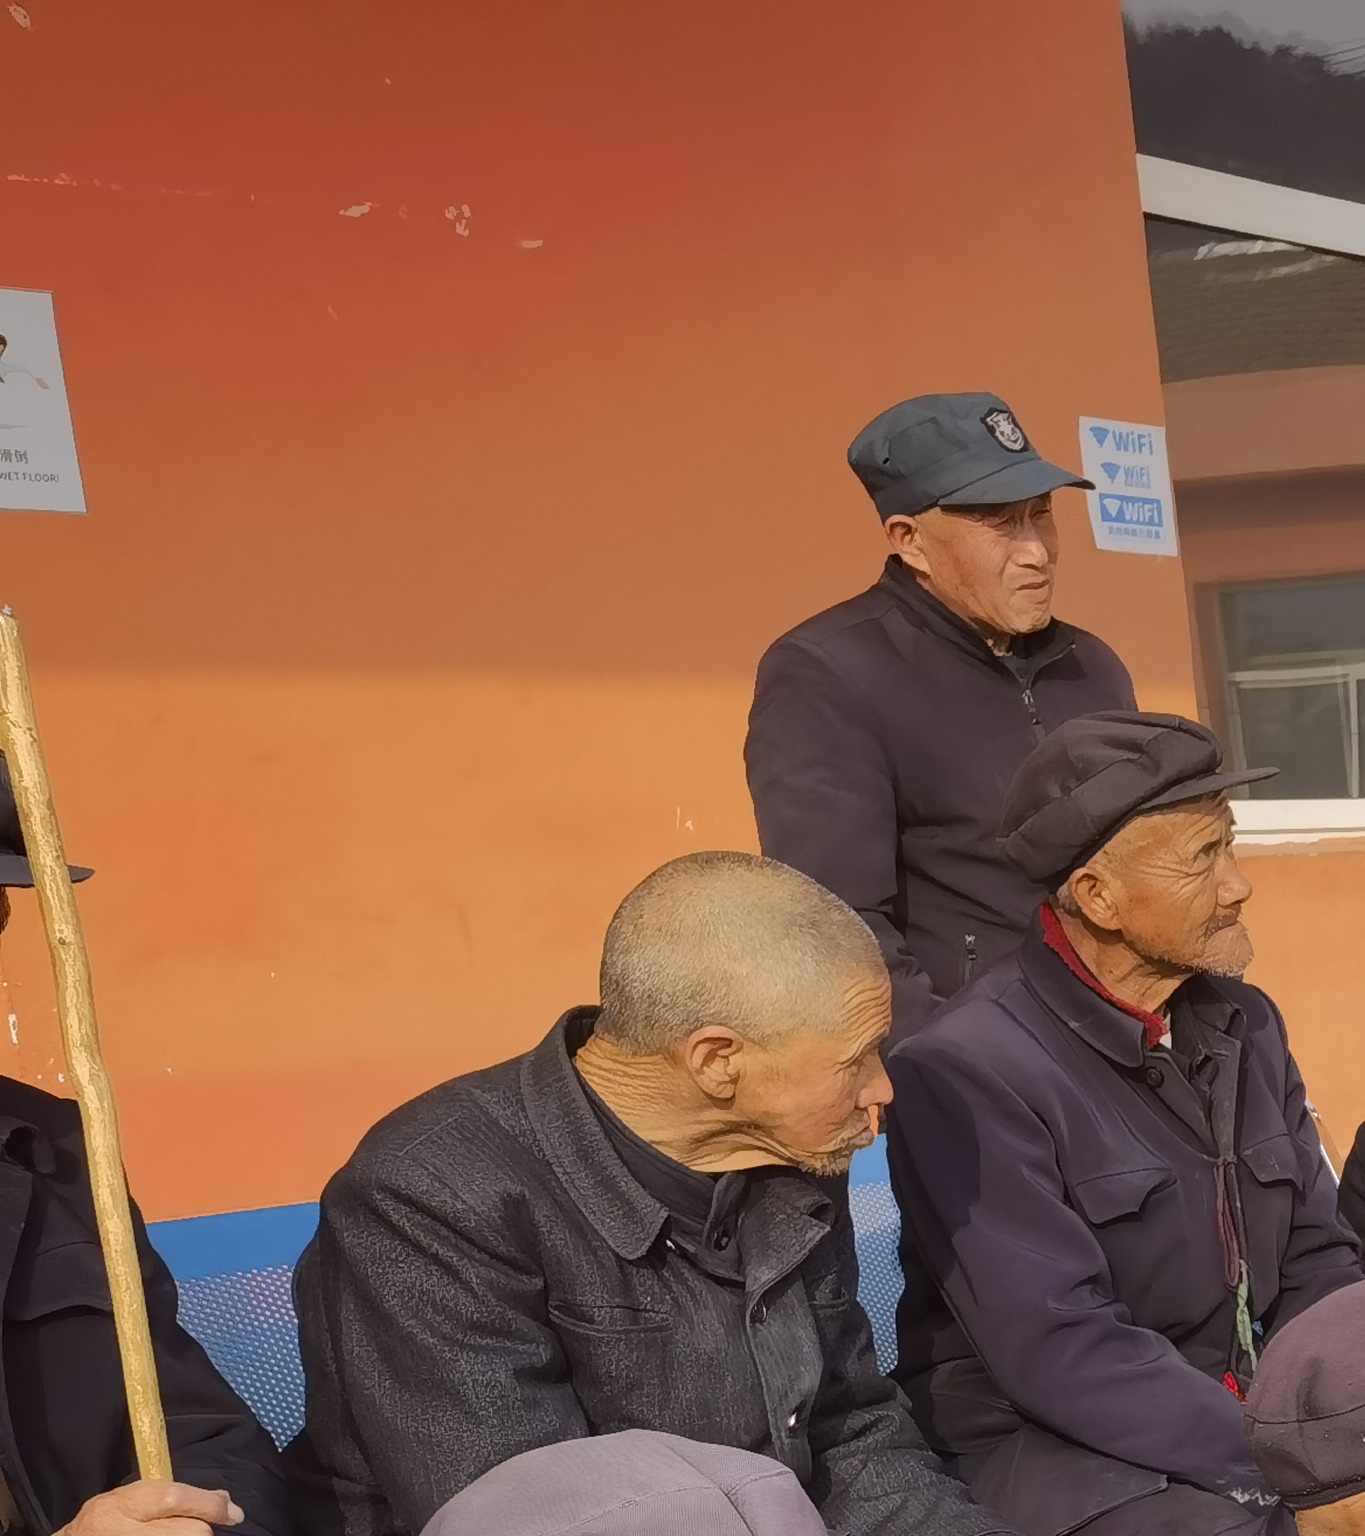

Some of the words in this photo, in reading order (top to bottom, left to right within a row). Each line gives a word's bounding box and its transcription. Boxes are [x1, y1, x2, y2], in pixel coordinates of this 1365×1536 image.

[1112, 429, 1154, 456] WiFi
[1123, 465, 1149, 484] WiFi
[1122, 501, 1160, 524] WiFi
